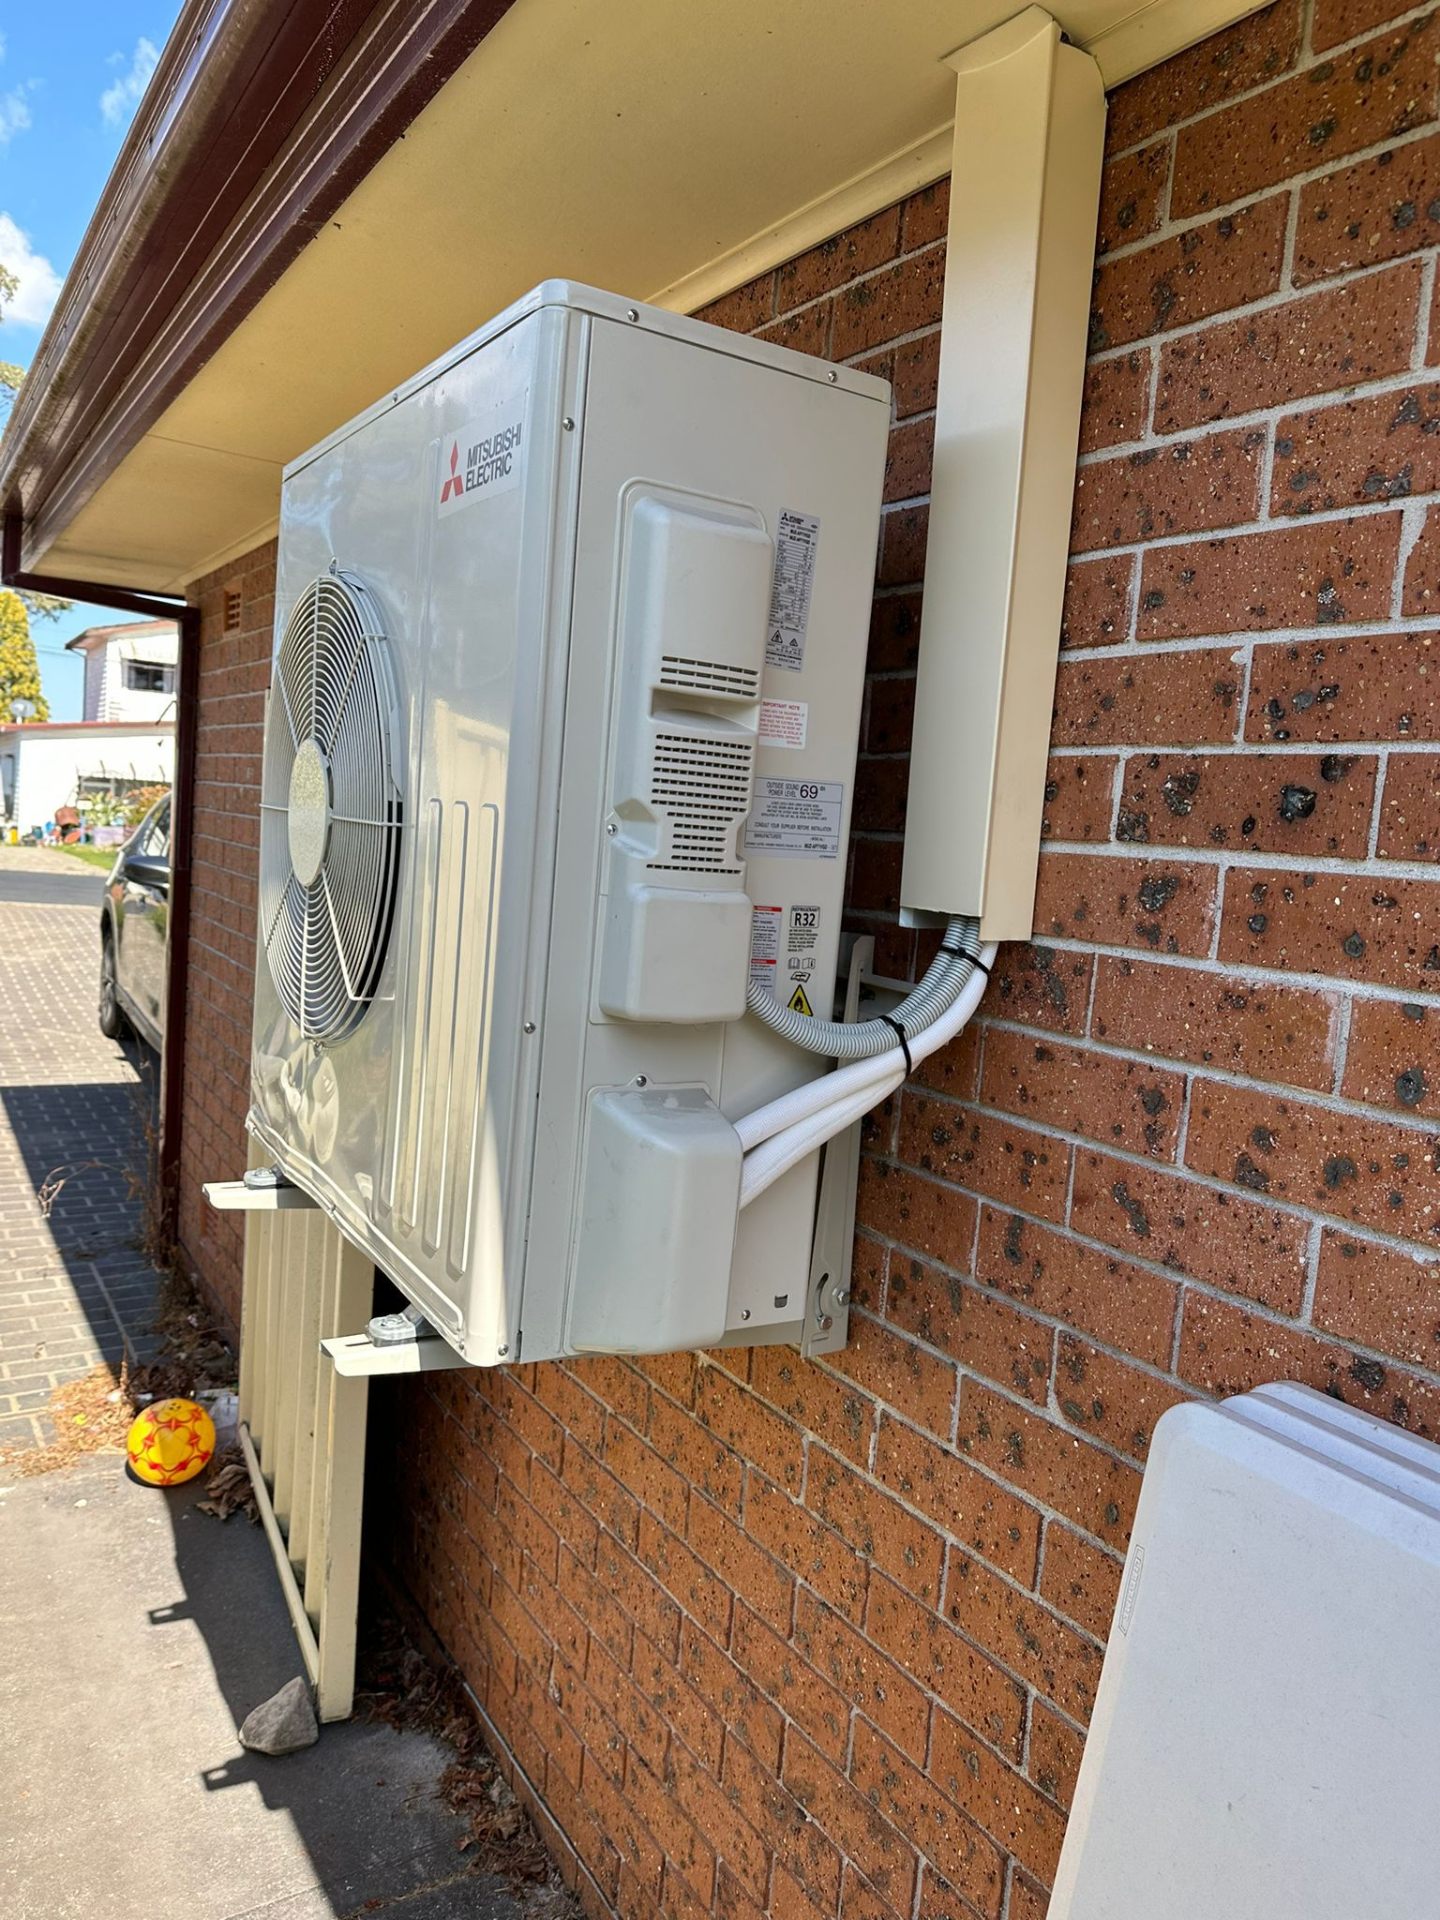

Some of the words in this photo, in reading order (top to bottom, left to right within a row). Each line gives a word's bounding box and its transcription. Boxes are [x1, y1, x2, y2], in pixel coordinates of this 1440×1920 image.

[467, 423, 522, 469] MITSUBISHI
[465, 452, 512, 492] ELECTRIC
[766, 781, 784, 789] OUTSIDE
[800, 784, 818, 799] 69
[785, 790, 797, 798] LEVEL
[794, 912, 816, 927] R32
